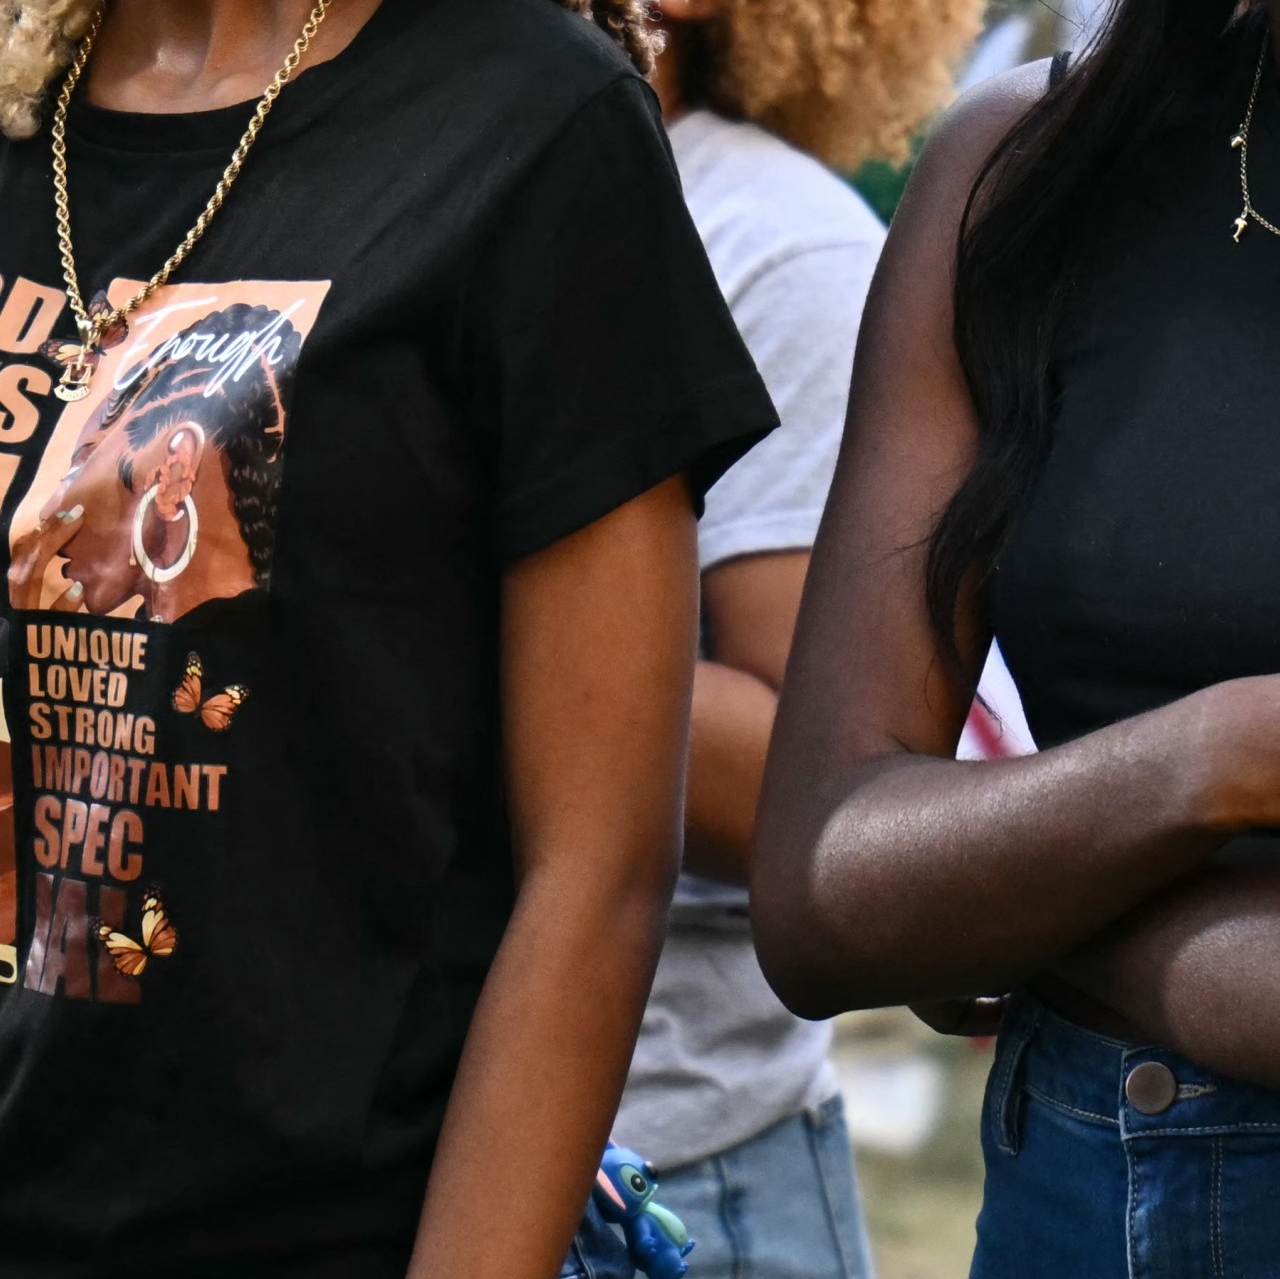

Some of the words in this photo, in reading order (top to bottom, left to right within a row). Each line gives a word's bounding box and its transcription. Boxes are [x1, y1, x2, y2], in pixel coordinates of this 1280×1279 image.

[114, 296, 306, 398] Enough
[26, 624, 148, 670] UNIQUE
[28, 663, 128, 707] LOVED
[29, 702, 156, 755] STRONG
[31, 743, 228, 811] IMPORTANT
[33, 794, 144, 882] SPEC
[24, 871, 143, 1005] IAL
